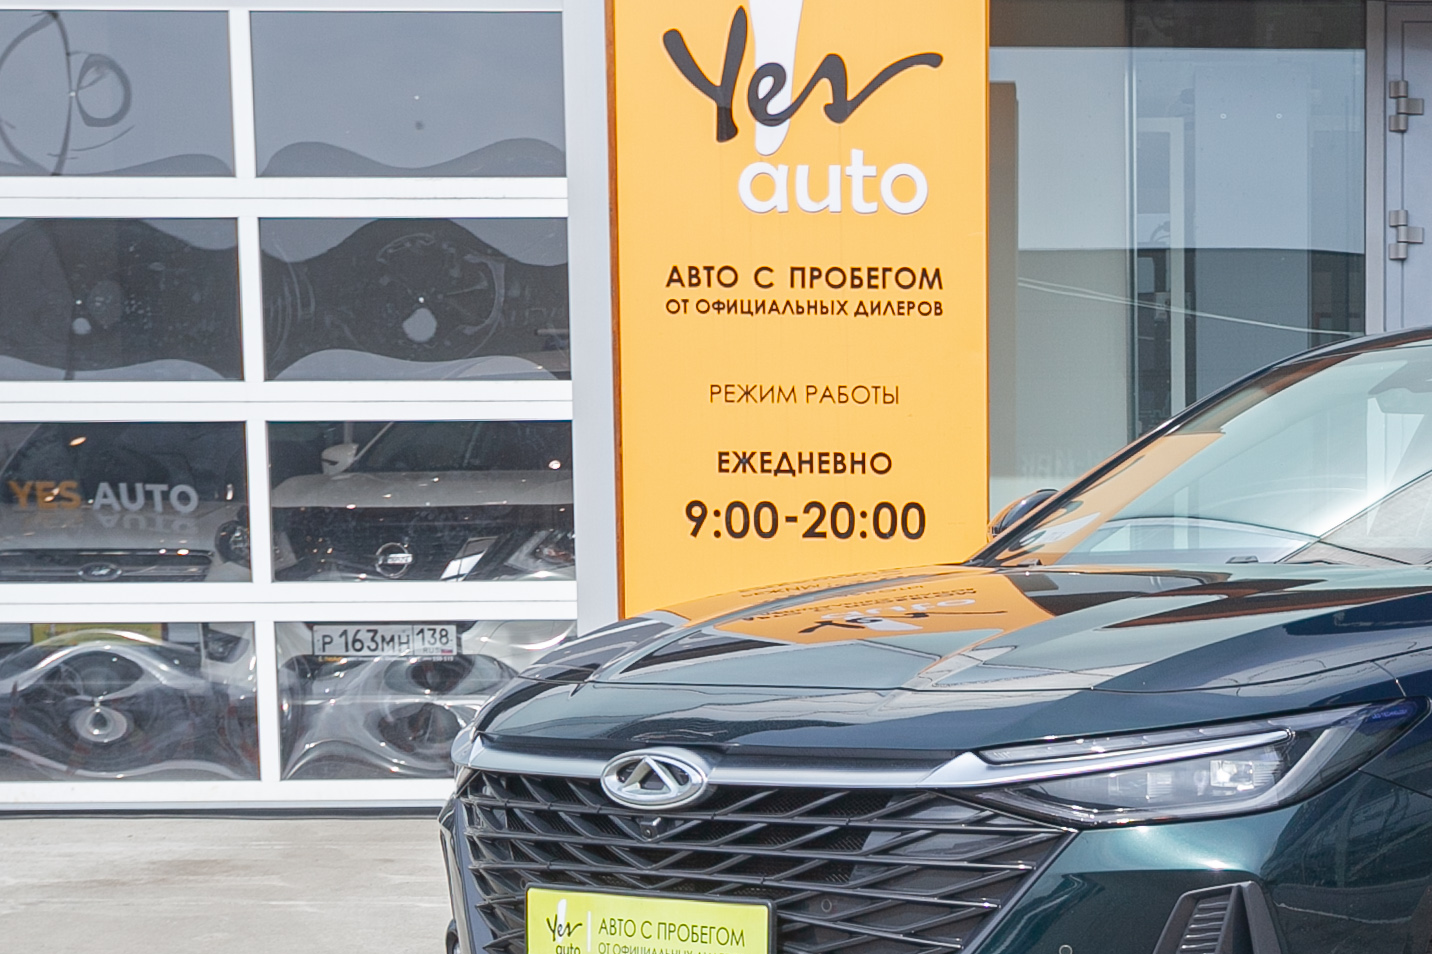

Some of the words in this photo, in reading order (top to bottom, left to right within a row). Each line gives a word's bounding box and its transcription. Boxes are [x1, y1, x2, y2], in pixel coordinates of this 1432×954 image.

[663, 5, 943, 143] Yes
[738, 149, 928, 214] auto
[665, 266, 738, 289] АВТО
[754, 266, 774, 289] С
[790, 266, 943, 289] ПРОБЕГОМ
[665, 299, 689, 315] ОТ
[696, 299, 848, 316] ОФИЦИАЛЬНЫХ
[854, 300, 943, 317] ДИЛЕРОВ
[710, 384, 796, 404] РЕЖИМ
[806, 384, 899, 405] РАБОТЫ
[717, 450, 893, 478] ЕЖЕДНЕВНО
[8, 480, 81, 510] YES
[93, 482, 199, 514] AUTO
[685, 500, 926, 540] 9:00-20:00
[416, 628, 449, 646] 138
[546, 914, 583, 942] Yes
[598, 918, 636, 938] АВТО
[641, 920, 653, 939] С
[657, 922, 745, 947] ПРОБЕГОМ
[598, 942, 610, 954] ОТ
